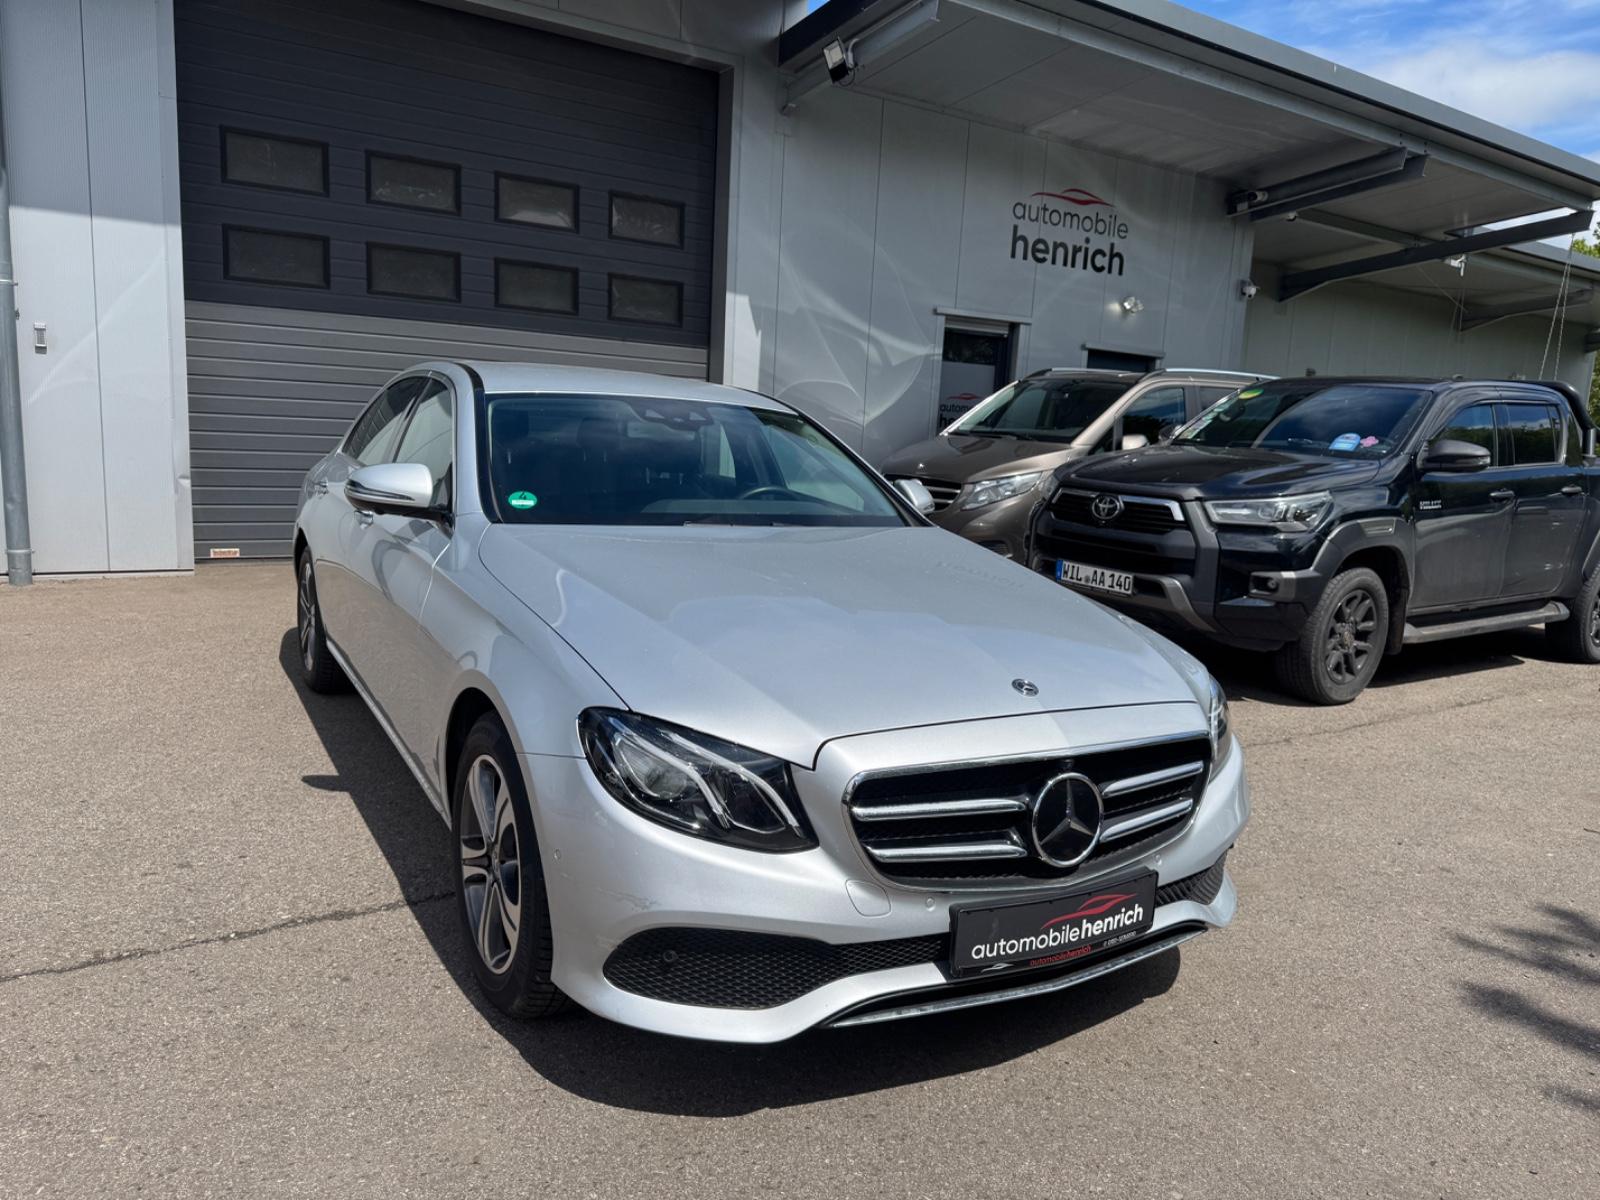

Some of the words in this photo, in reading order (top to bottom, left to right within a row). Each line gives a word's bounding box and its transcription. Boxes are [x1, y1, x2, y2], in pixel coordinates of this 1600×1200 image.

[1012, 201, 1129, 239] automobile
[1010, 223, 1125, 276] henrich
[940, 403, 970, 413] autom
[1062, 563, 1082, 582] WIL
[1091, 569, 1106, 588] AA
[1107, 573, 1131, 592] 140
